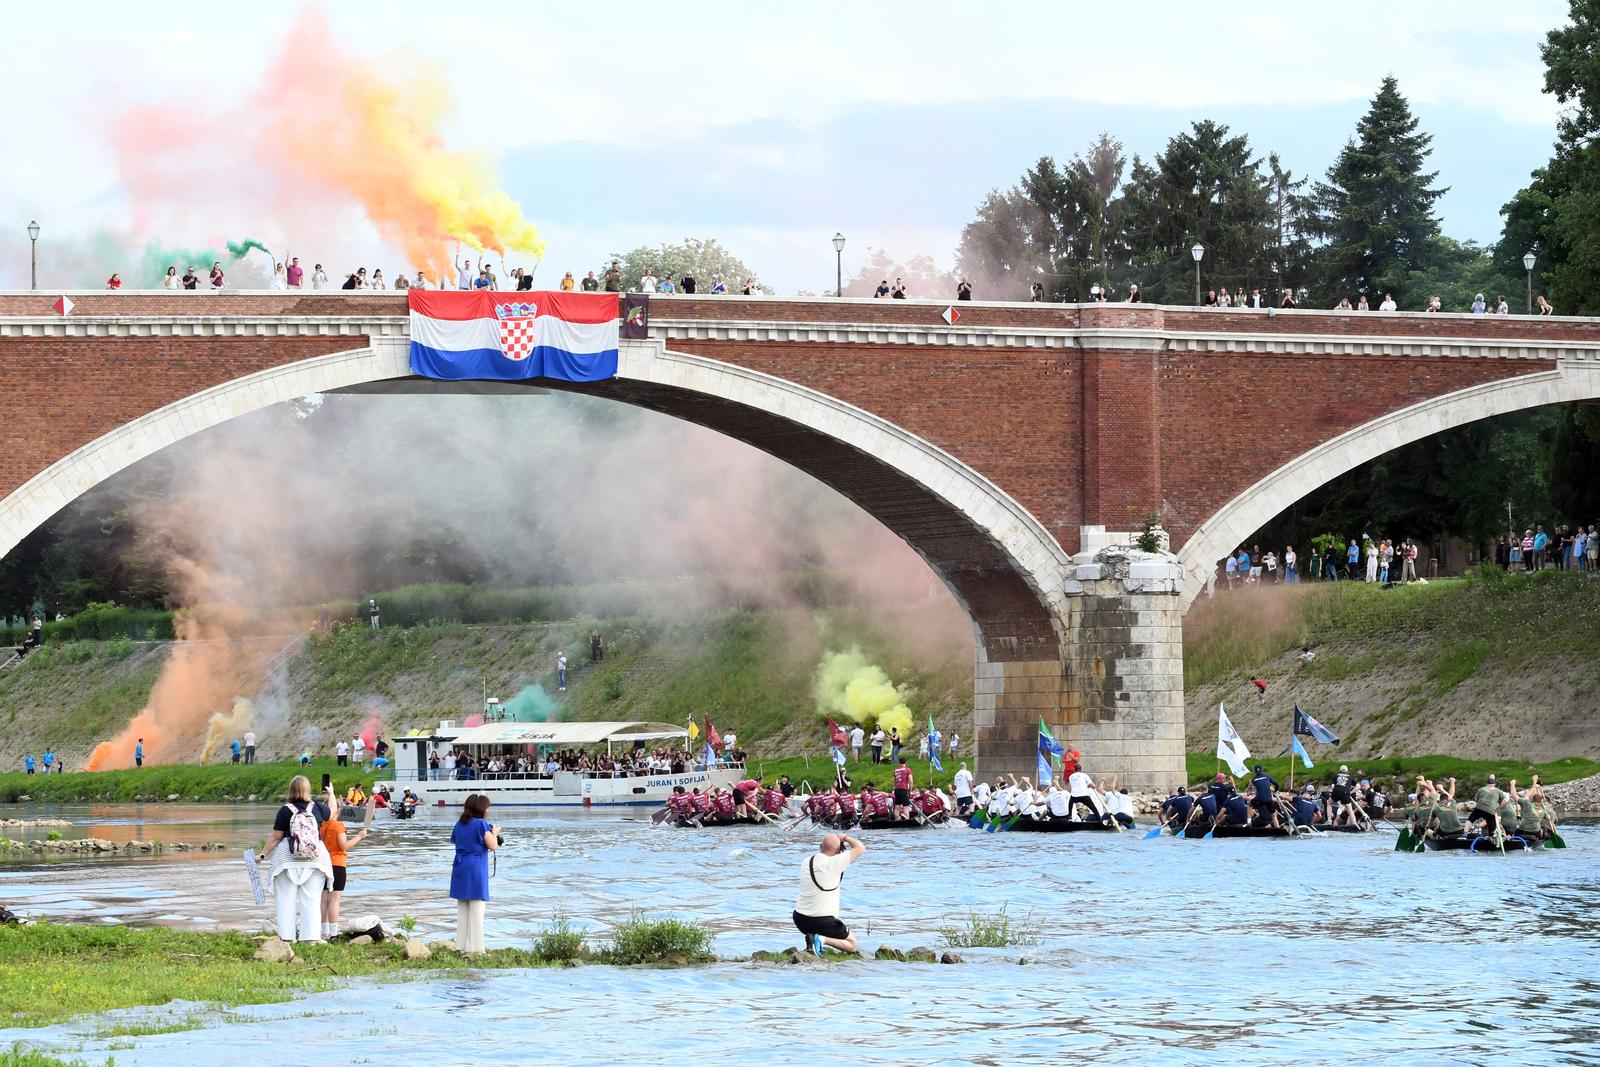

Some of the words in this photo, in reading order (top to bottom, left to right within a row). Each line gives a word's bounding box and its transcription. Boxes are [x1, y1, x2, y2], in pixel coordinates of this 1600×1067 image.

[517, 732, 557, 740] Sisak
[646, 779, 672, 787] JURAN
[679, 775, 706, 785] SOFIJA
